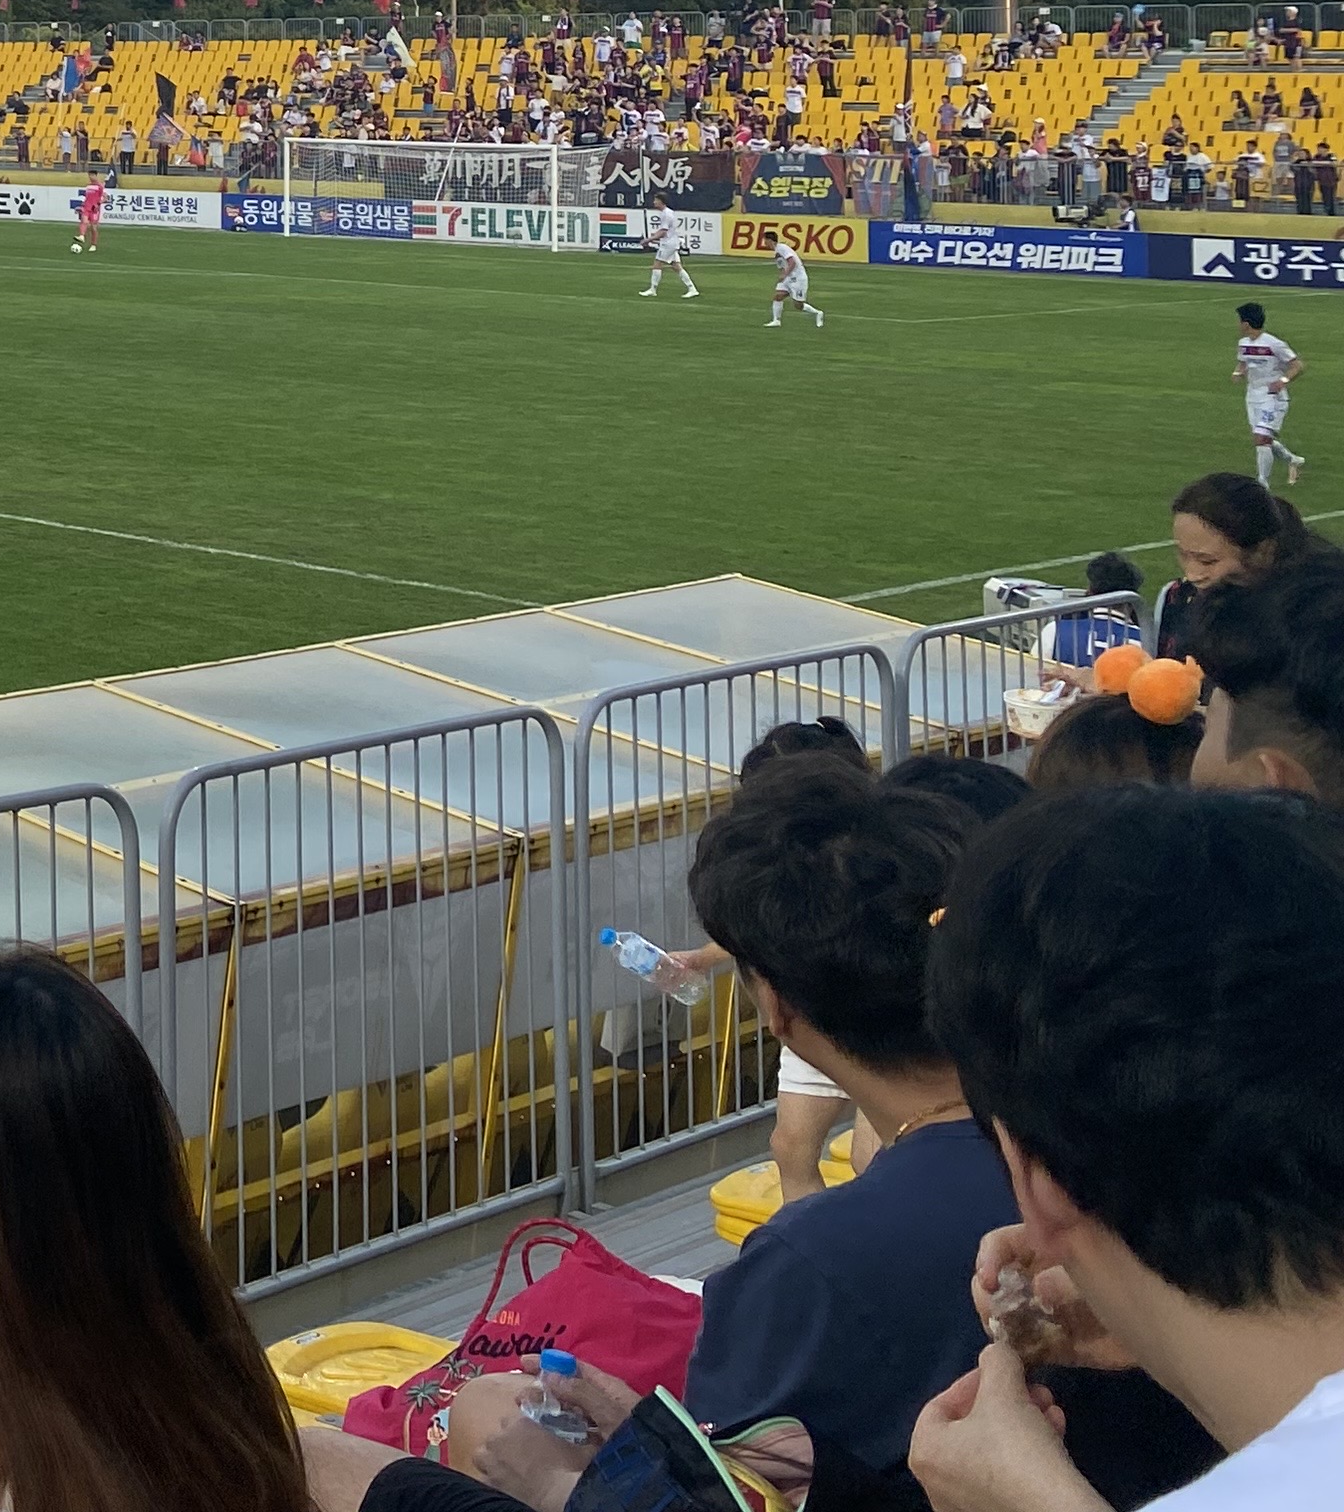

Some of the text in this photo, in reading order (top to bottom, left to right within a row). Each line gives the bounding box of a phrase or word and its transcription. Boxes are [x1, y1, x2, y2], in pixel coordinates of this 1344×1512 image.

[137, 214, 165, 222] CENTRAL
[167, 216, 198, 224] HOSPITAL
[337, 202, 411, 232] 동원샘물
[731, 220, 854, 255] BESKO
[889, 239, 934, 263] 여수
[1016, 243, 1124, 273] 워터파크
[454, 1322, 568, 1361] awaii
